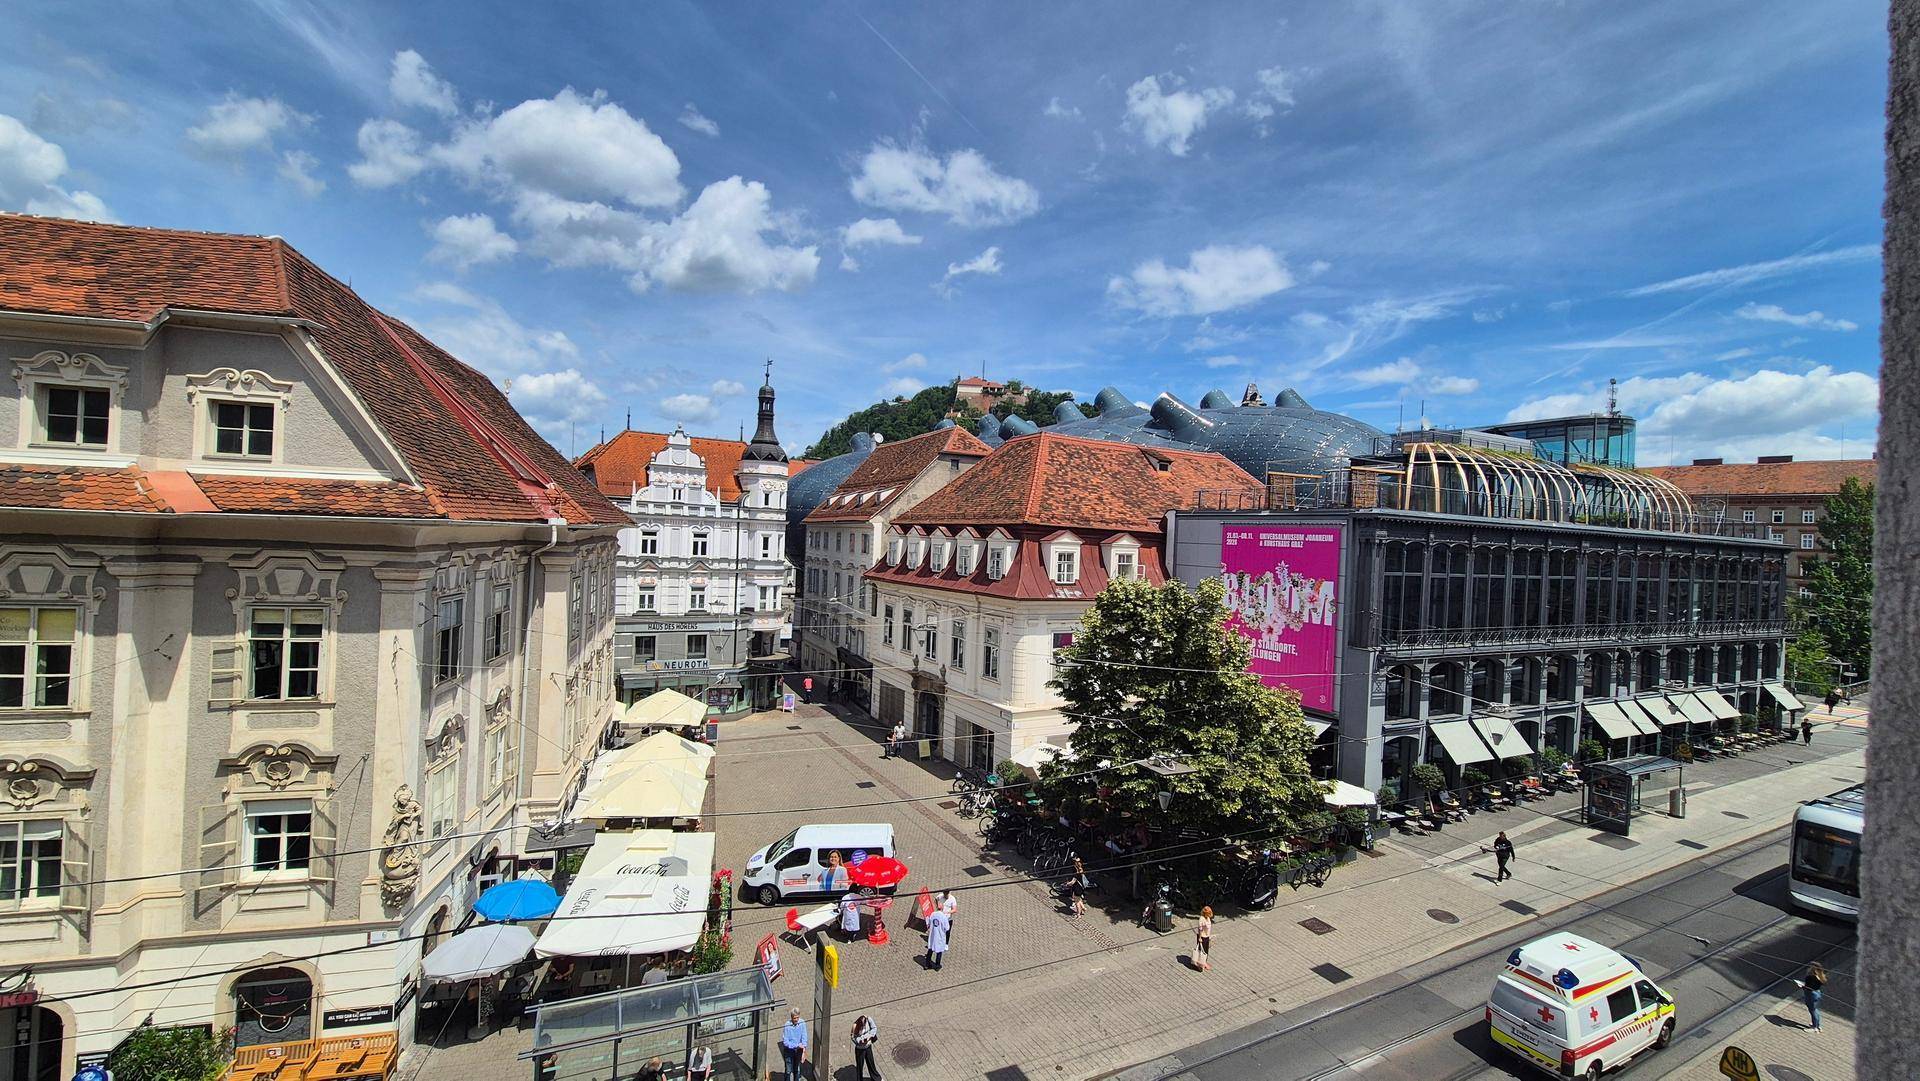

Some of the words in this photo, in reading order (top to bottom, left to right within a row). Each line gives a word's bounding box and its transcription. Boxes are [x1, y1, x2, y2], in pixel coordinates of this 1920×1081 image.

[1223, 572, 1335, 627] BLOOM
[648, 623, 663, 631] HAUS
[664, 660, 709, 669] NEUROTH
